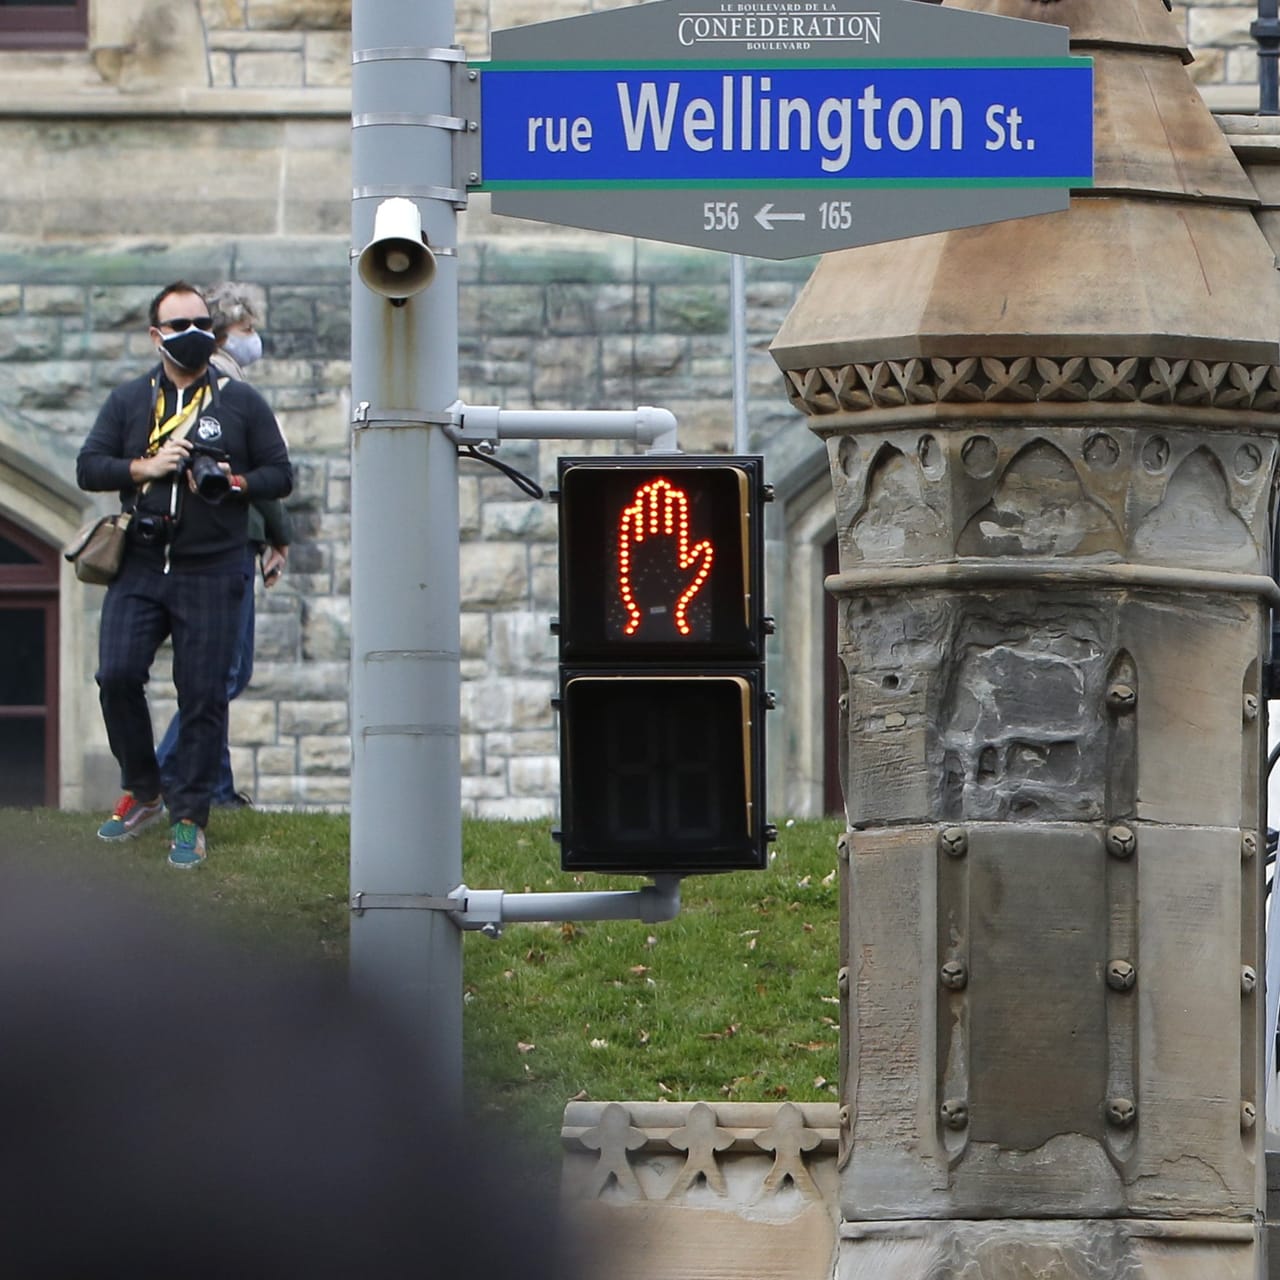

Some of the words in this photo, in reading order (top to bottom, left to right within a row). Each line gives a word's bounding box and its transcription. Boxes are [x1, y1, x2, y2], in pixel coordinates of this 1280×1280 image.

[720, 3, 734, 12] LE
[737, 3, 801, 12] BOULEVARD
[804, 3, 821, 12] DE
[822, 3, 837, 12] LA
[746, 42, 811, 51] BOULEVARD
[528, 117, 592, 153] rue
[616, 75, 963, 172] Wellington
[985, 104, 1035, 151] St.
[703, 202, 739, 231] 556
[818, 201, 852, 230] 165
